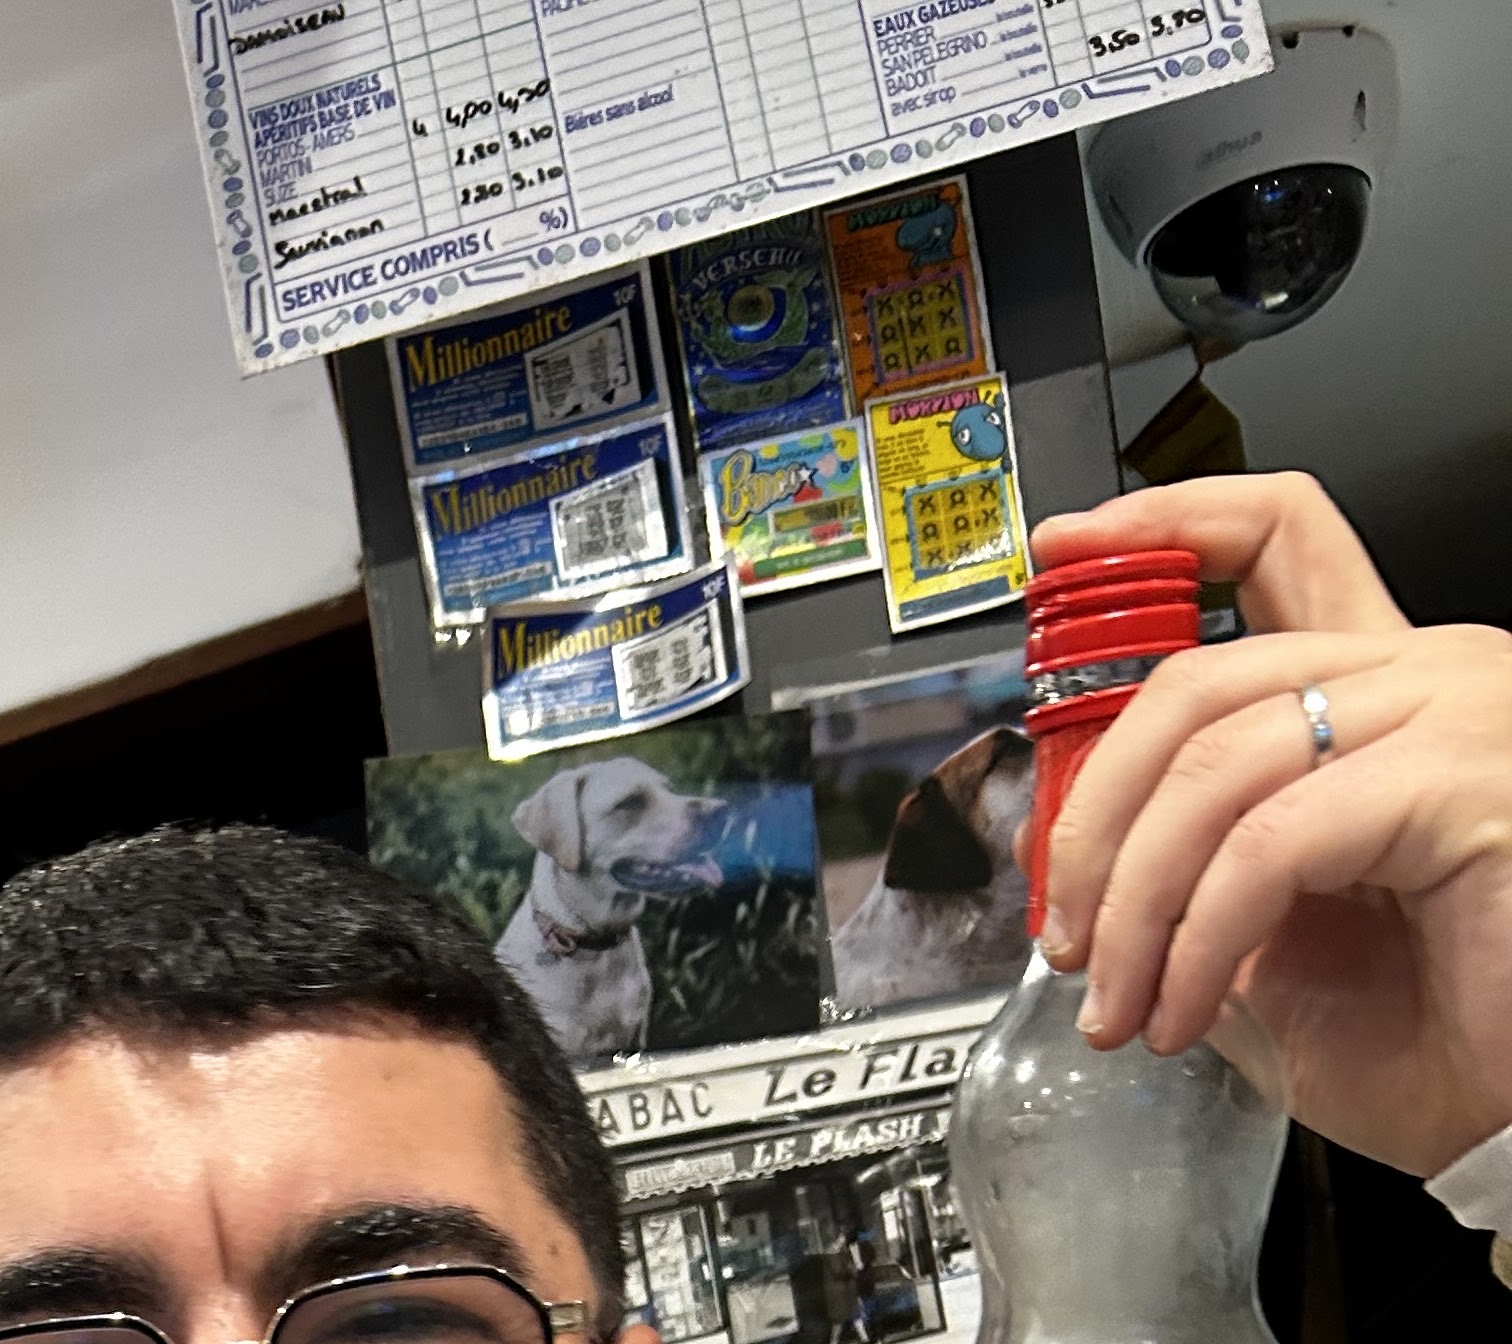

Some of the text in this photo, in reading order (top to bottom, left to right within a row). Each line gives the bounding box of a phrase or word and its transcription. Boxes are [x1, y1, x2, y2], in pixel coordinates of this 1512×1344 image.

[873, 10, 916, 38] EAUX
[877, 25, 937, 57] PERRIER
[881, 55, 913, 78] SAN
[885, 65, 937, 97] BADOIT
[279, 90, 315, 121] DOUX
[315, 73, 382, 111] NATURELS
[317, 108, 353, 134] BASE
[353, 101, 374, 120] DE
[374, 88, 397, 113] VIN
[282, 265, 376, 312] SERVICE
[380, 233, 480, 281] COMPRIS
[404, 302, 574, 394] Millionnaire
[430, 450, 599, 540] Millionnaire
[497, 601, 664, 680] Millionnaire
[762, 1061, 838, 1107] Le
[751, 1141, 796, 1170] LE
